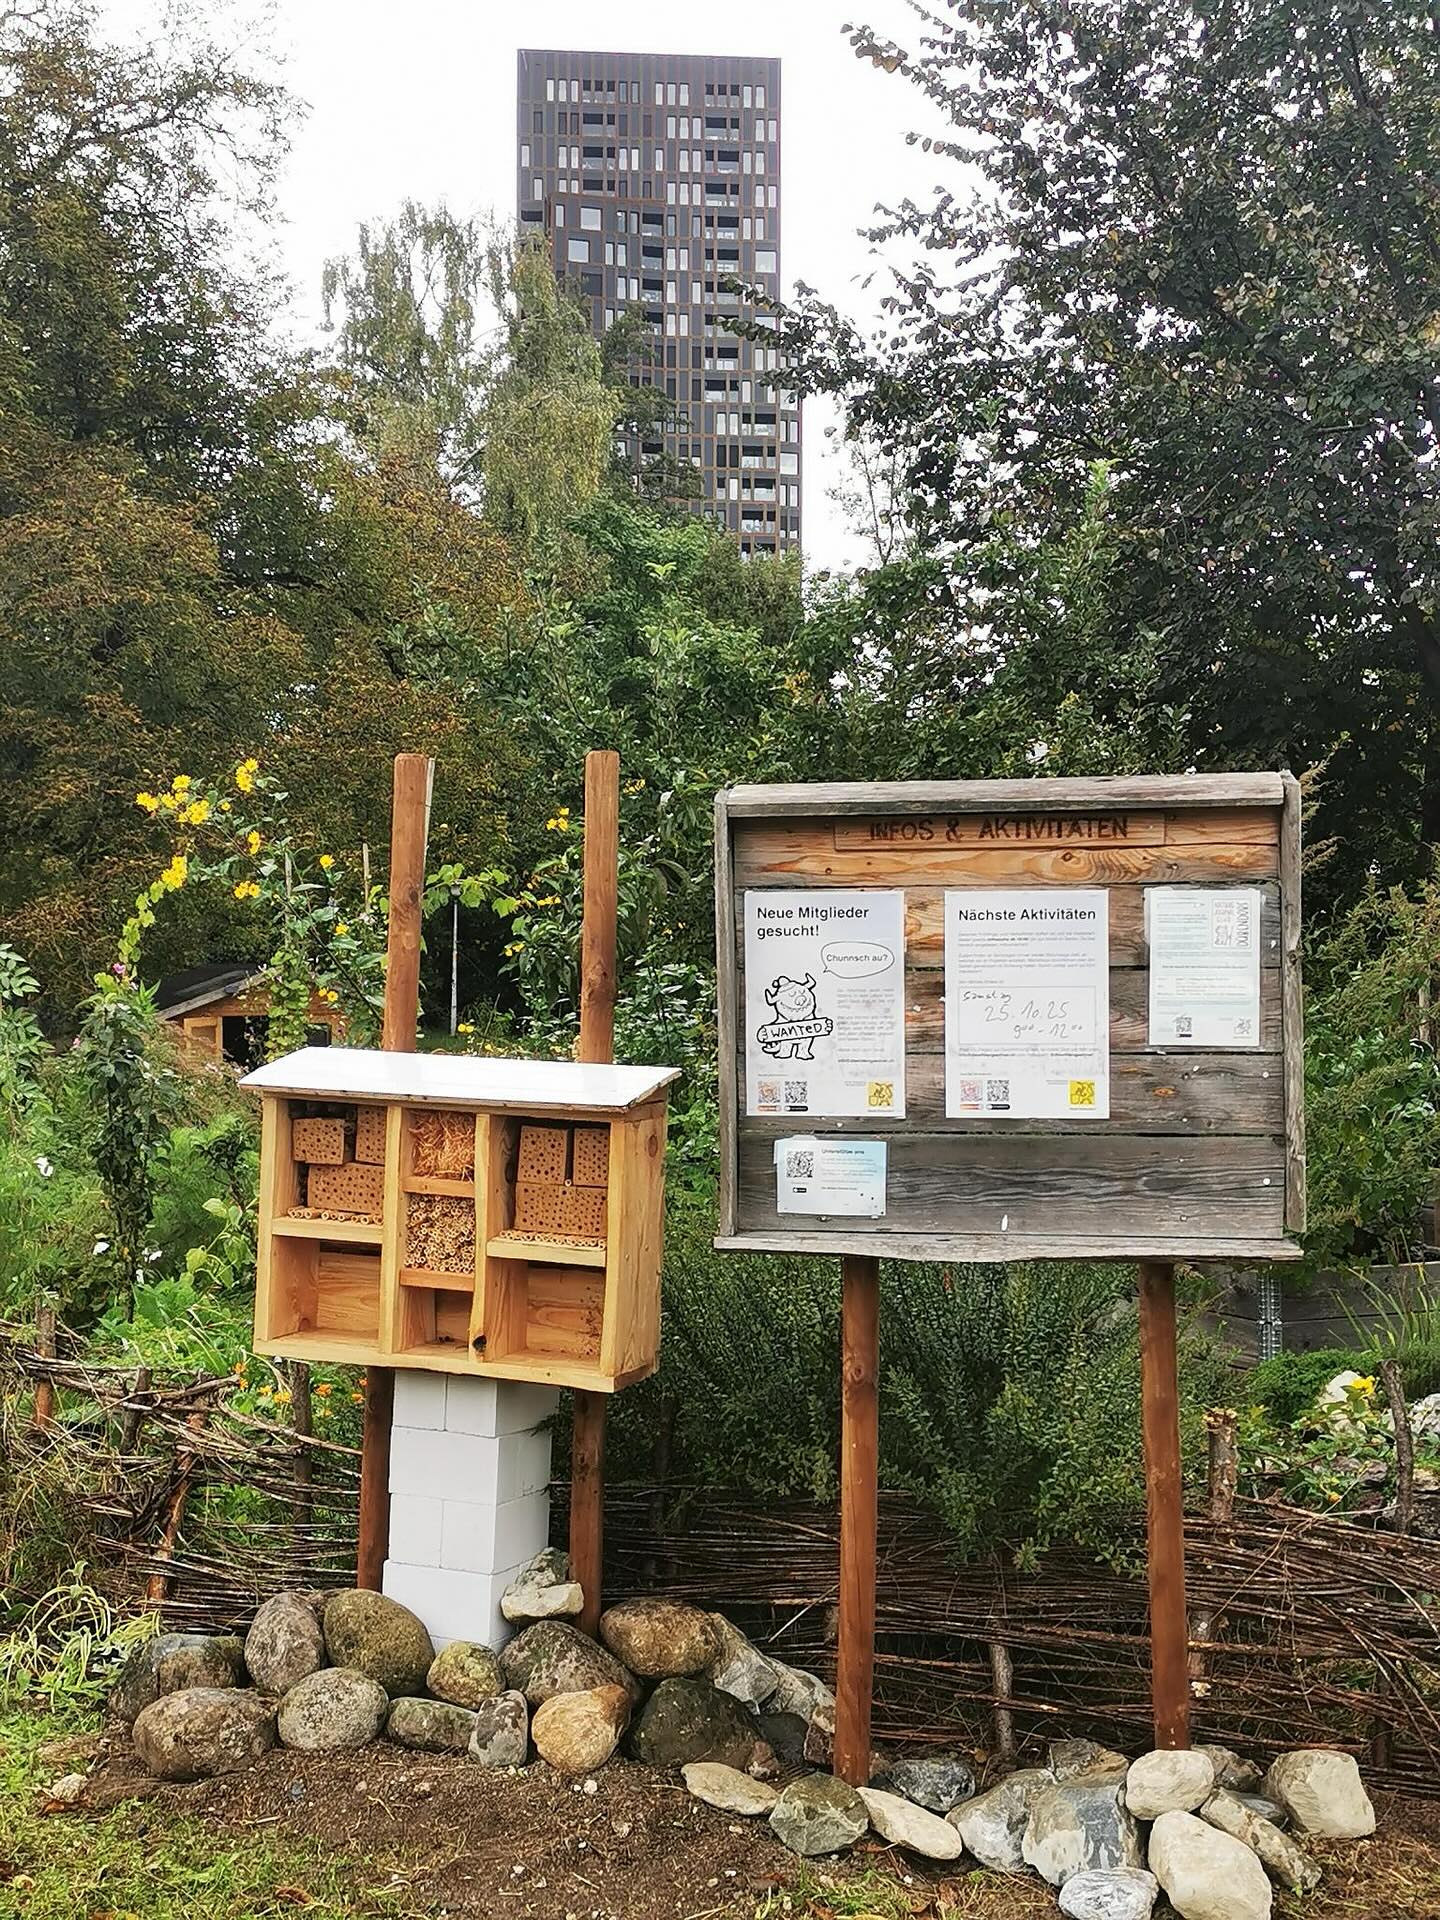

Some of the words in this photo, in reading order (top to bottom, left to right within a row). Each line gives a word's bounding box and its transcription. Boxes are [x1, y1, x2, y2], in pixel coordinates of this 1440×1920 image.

[870, 818, 933, 841] INFOS
[945, 817, 962, 843] &
[757, 907, 793, 919] Neue
[798, 906, 869, 921] Mitglieder
[958, 908, 1016, 921] Nächste
[1020, 908, 1096, 920] Aktivitäten
[757, 925, 820, 940] gesucht!
[826, 954, 870, 962] Chunnsch
[872, 954, 888, 962] au?
